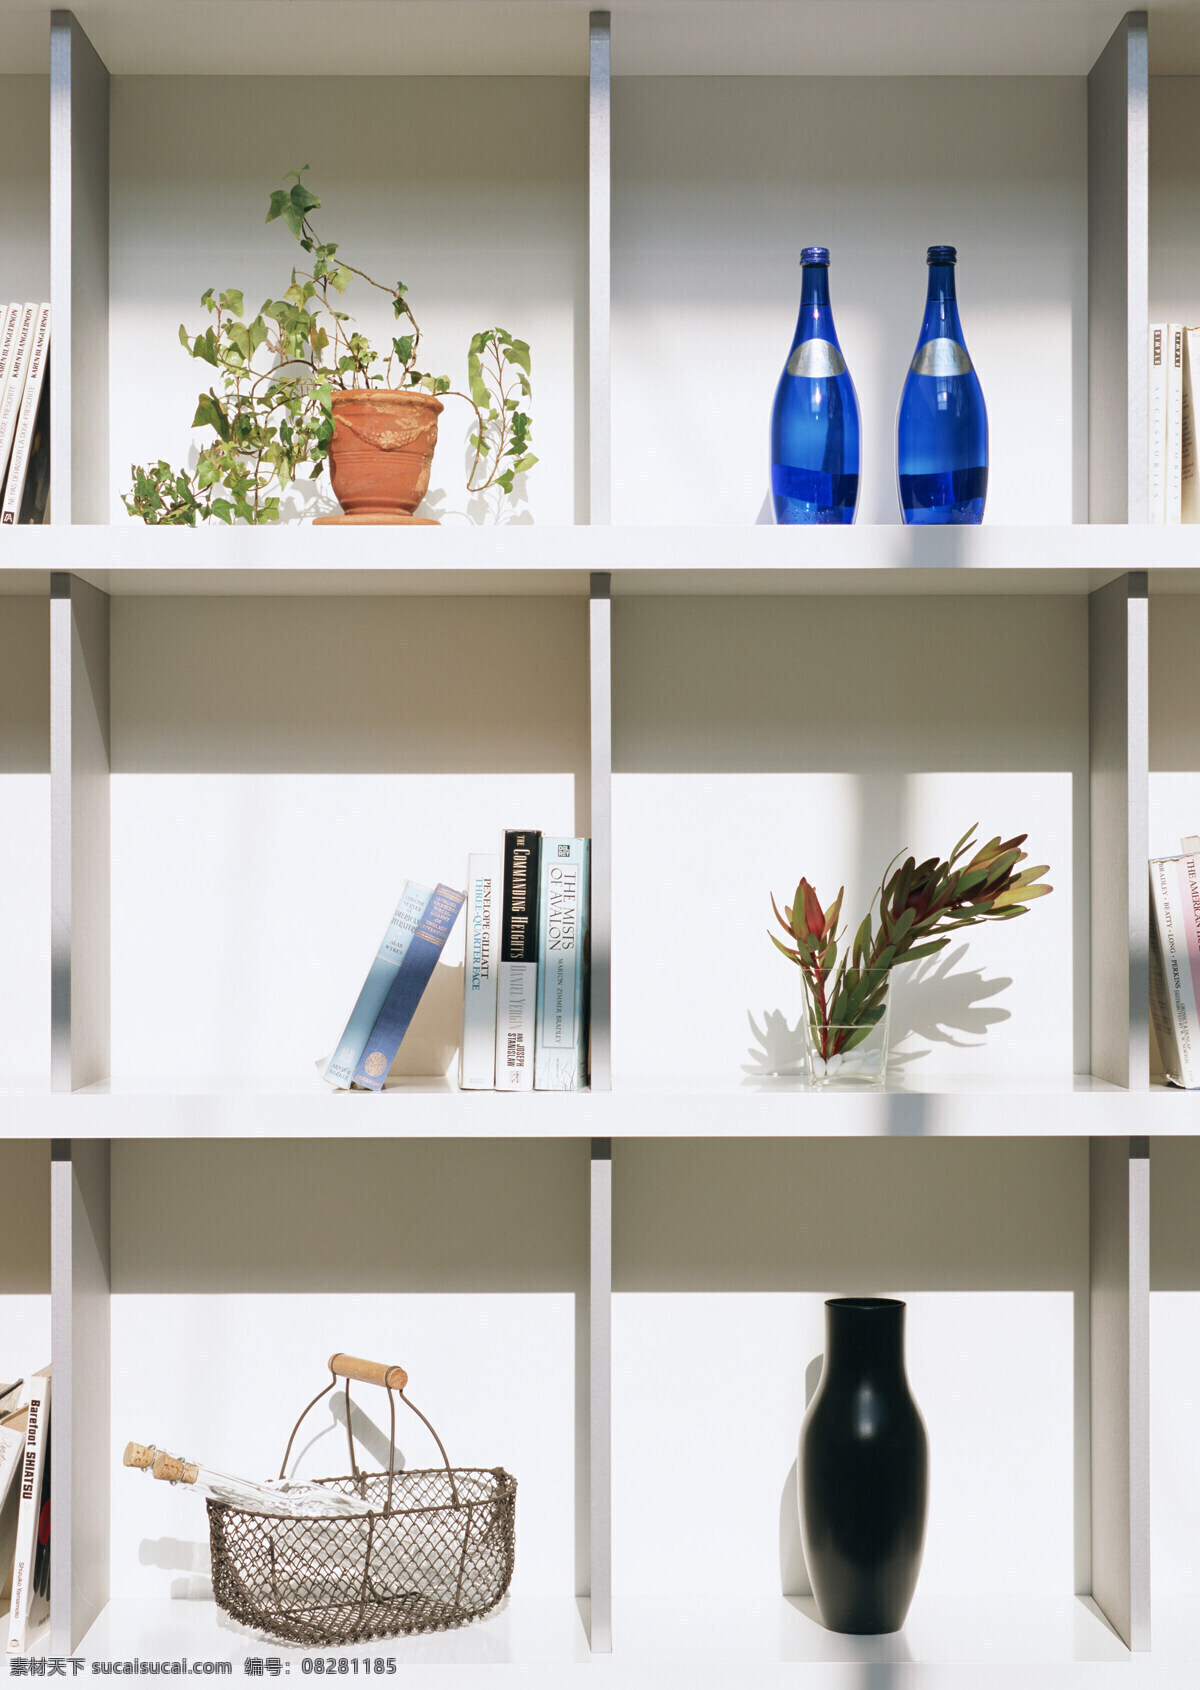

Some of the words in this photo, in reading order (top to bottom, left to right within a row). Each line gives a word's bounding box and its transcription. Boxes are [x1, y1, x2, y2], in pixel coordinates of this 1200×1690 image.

[12, 356, 22, 378] KAREN
[17, 308, 32, 356] BLANGUERNON
[35, 308, 49, 357] BLANGUERNON
[31, 356, 40, 378] KAREN
[20, 421, 28, 438] DOSE
[516, 835, 525, 846] THE
[511, 849, 531, 912] COMMANDING
[550, 868, 563, 887] OF
[1158, 862, 1168, 896] BRADLEY
[1186, 859, 1196, 878] THE
[563, 871, 576, 902] THE
[482, 878, 492, 930] PENELOPE
[548, 890, 562, 950] AVALON
[1164, 902, 1172, 928] BEATTY
[472, 877, 484, 964] THREE-QUARTER
[562, 907, 575, 949] MISTS
[510, 916, 529, 959] HEIGHTS
[1168, 933, 1176, 954] LONG
[481, 931, 490, 980] GILLIATT
[472, 966, 480, 991] FACE
[509, 965, 527, 996] DANIEL
[1171, 959, 1182, 989] PERKINS
[508, 999, 526, 1031] YERGIN
[556, 987, 564, 1014] ZIMMER
[507, 1032, 516, 1067] STANISLAW
[516, 1032, 524, 1043] AND
[516, 1043, 525, 1067] JOSEPH
[27, 1399, 40, 1446] Barefoot
[22, 1451, 36, 1500] SHIATSU
[14, 1587, 22, 1619] Yamamoto
